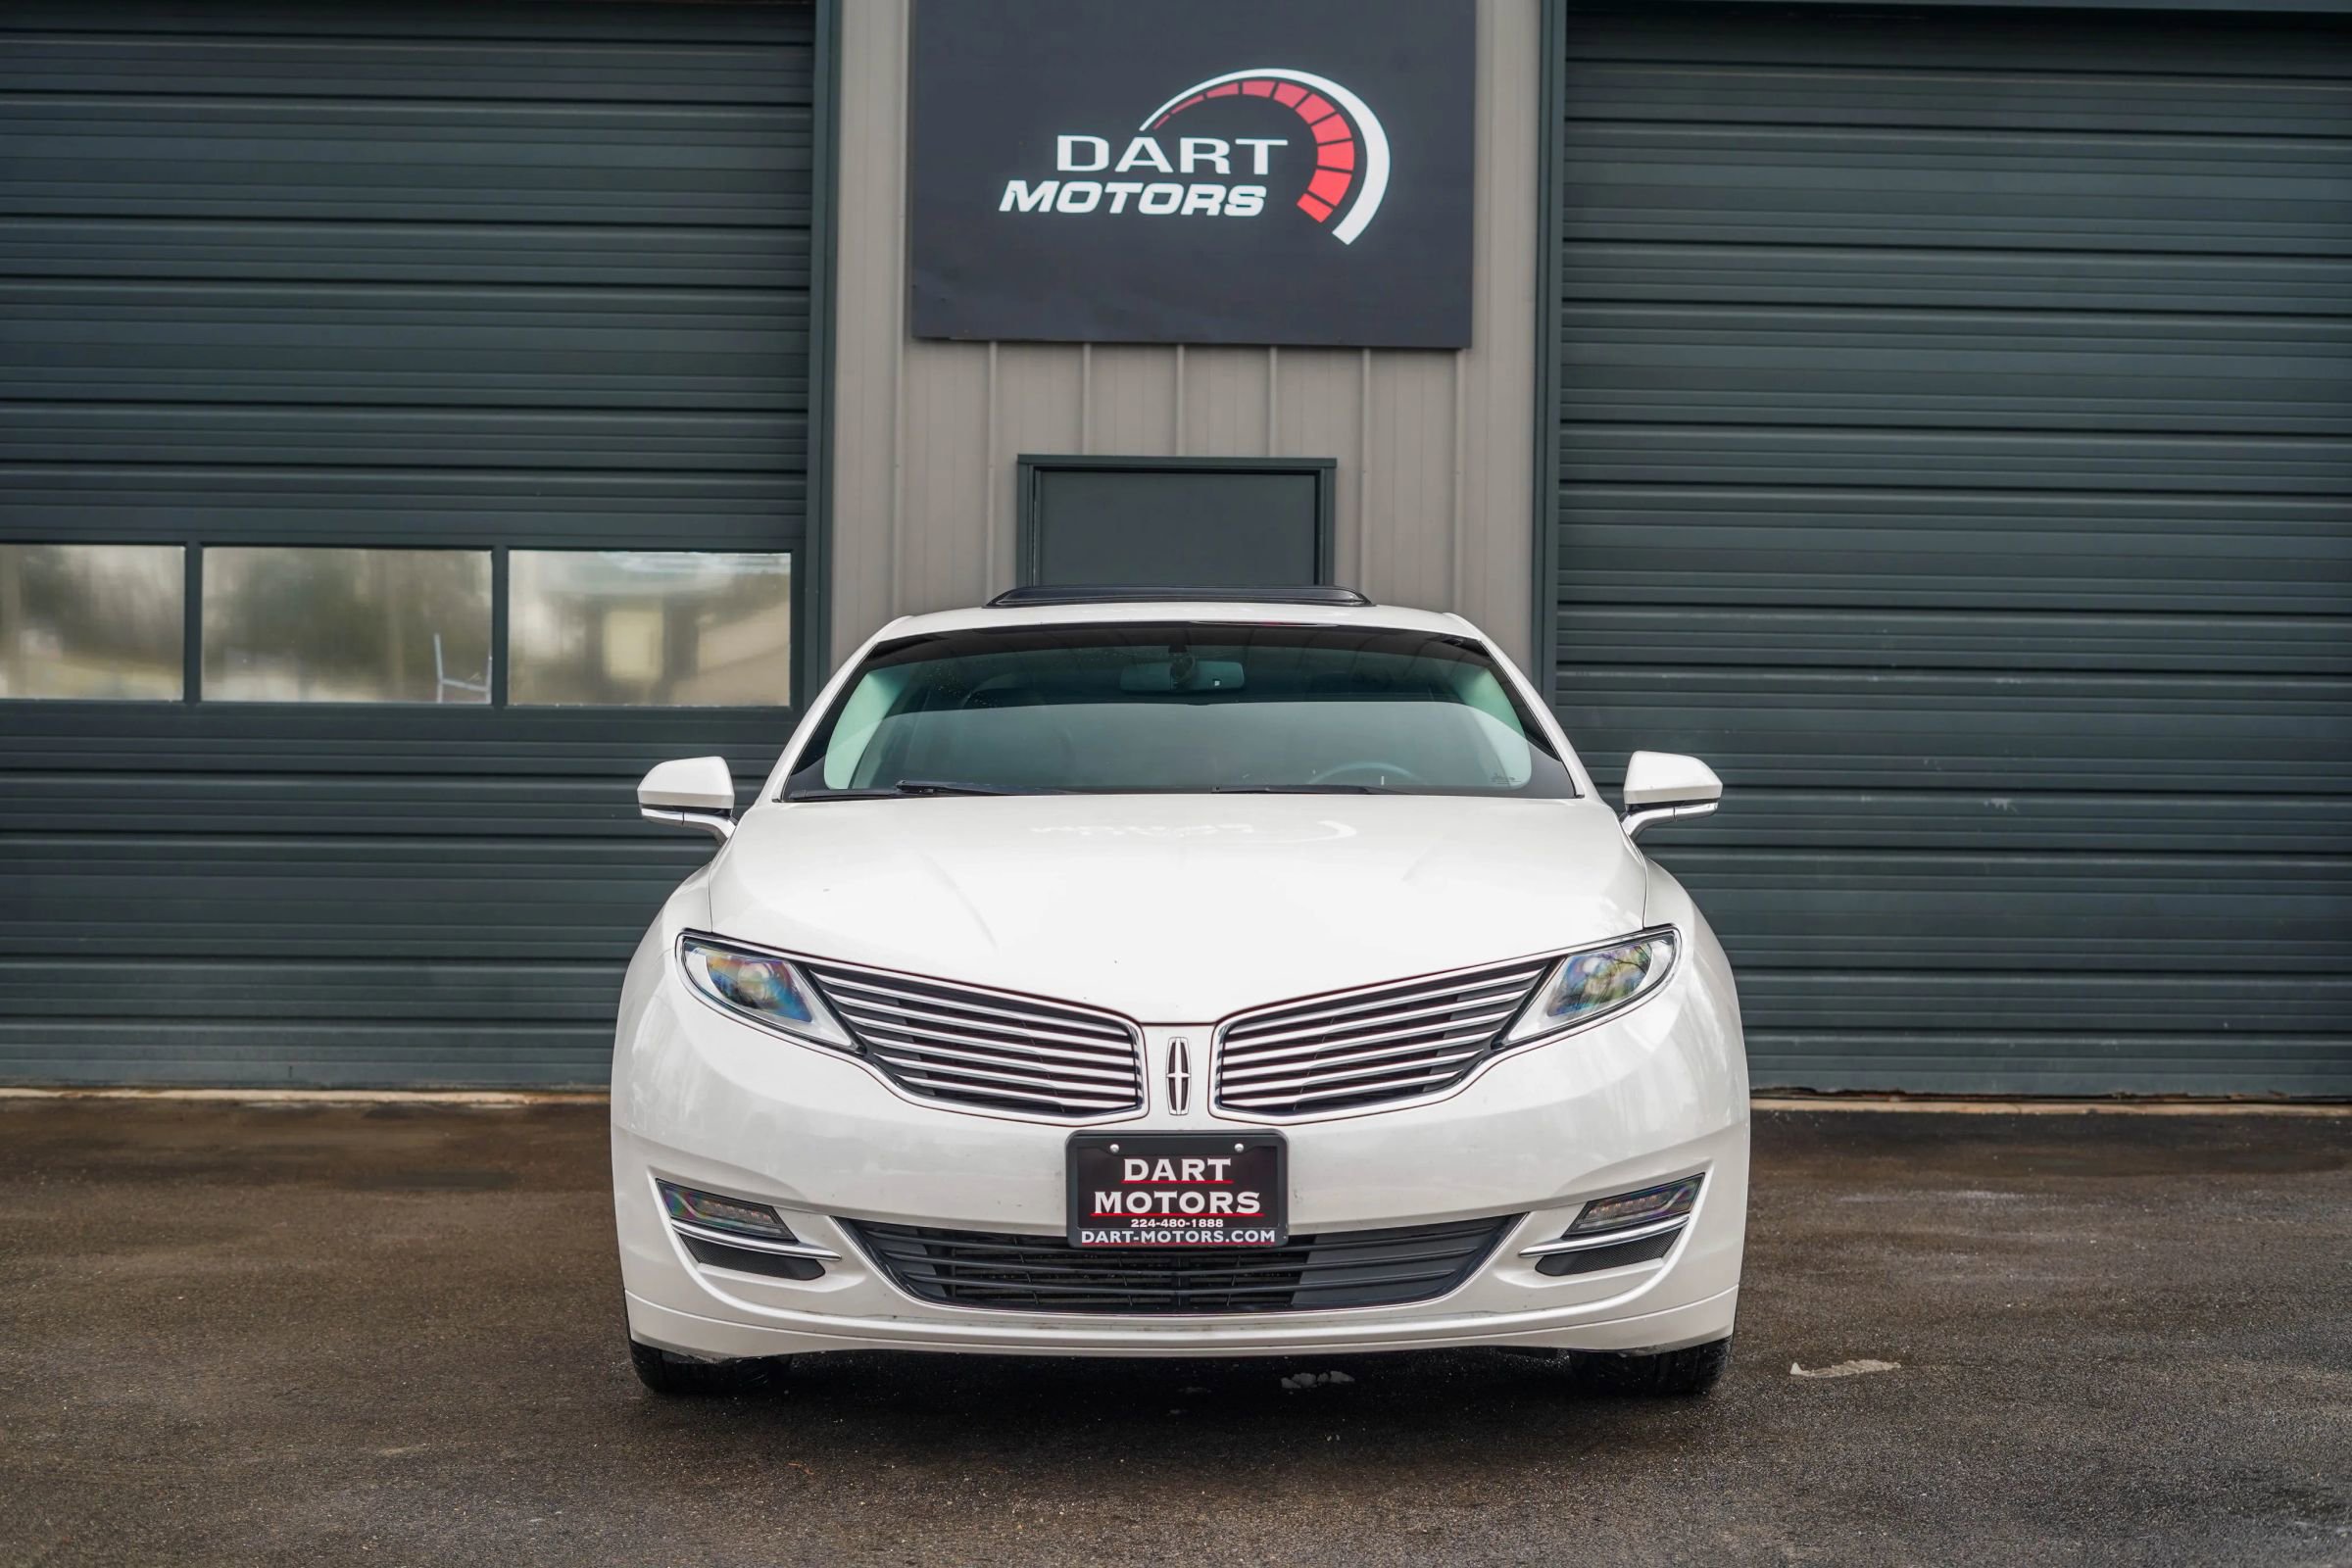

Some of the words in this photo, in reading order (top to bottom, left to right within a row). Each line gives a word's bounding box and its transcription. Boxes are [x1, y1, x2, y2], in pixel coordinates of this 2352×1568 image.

[1056, 134, 1289, 175] DART
[999, 180, 1267, 217] MOTORS
[1123, 1157, 1232, 1182] DART
[1094, 1190, 1261, 1214] MOTORS
[1130, 1218, 1224, 1228] 224-480-1888
[1081, 1230, 1276, 1244] DART-MOTORS.COM
